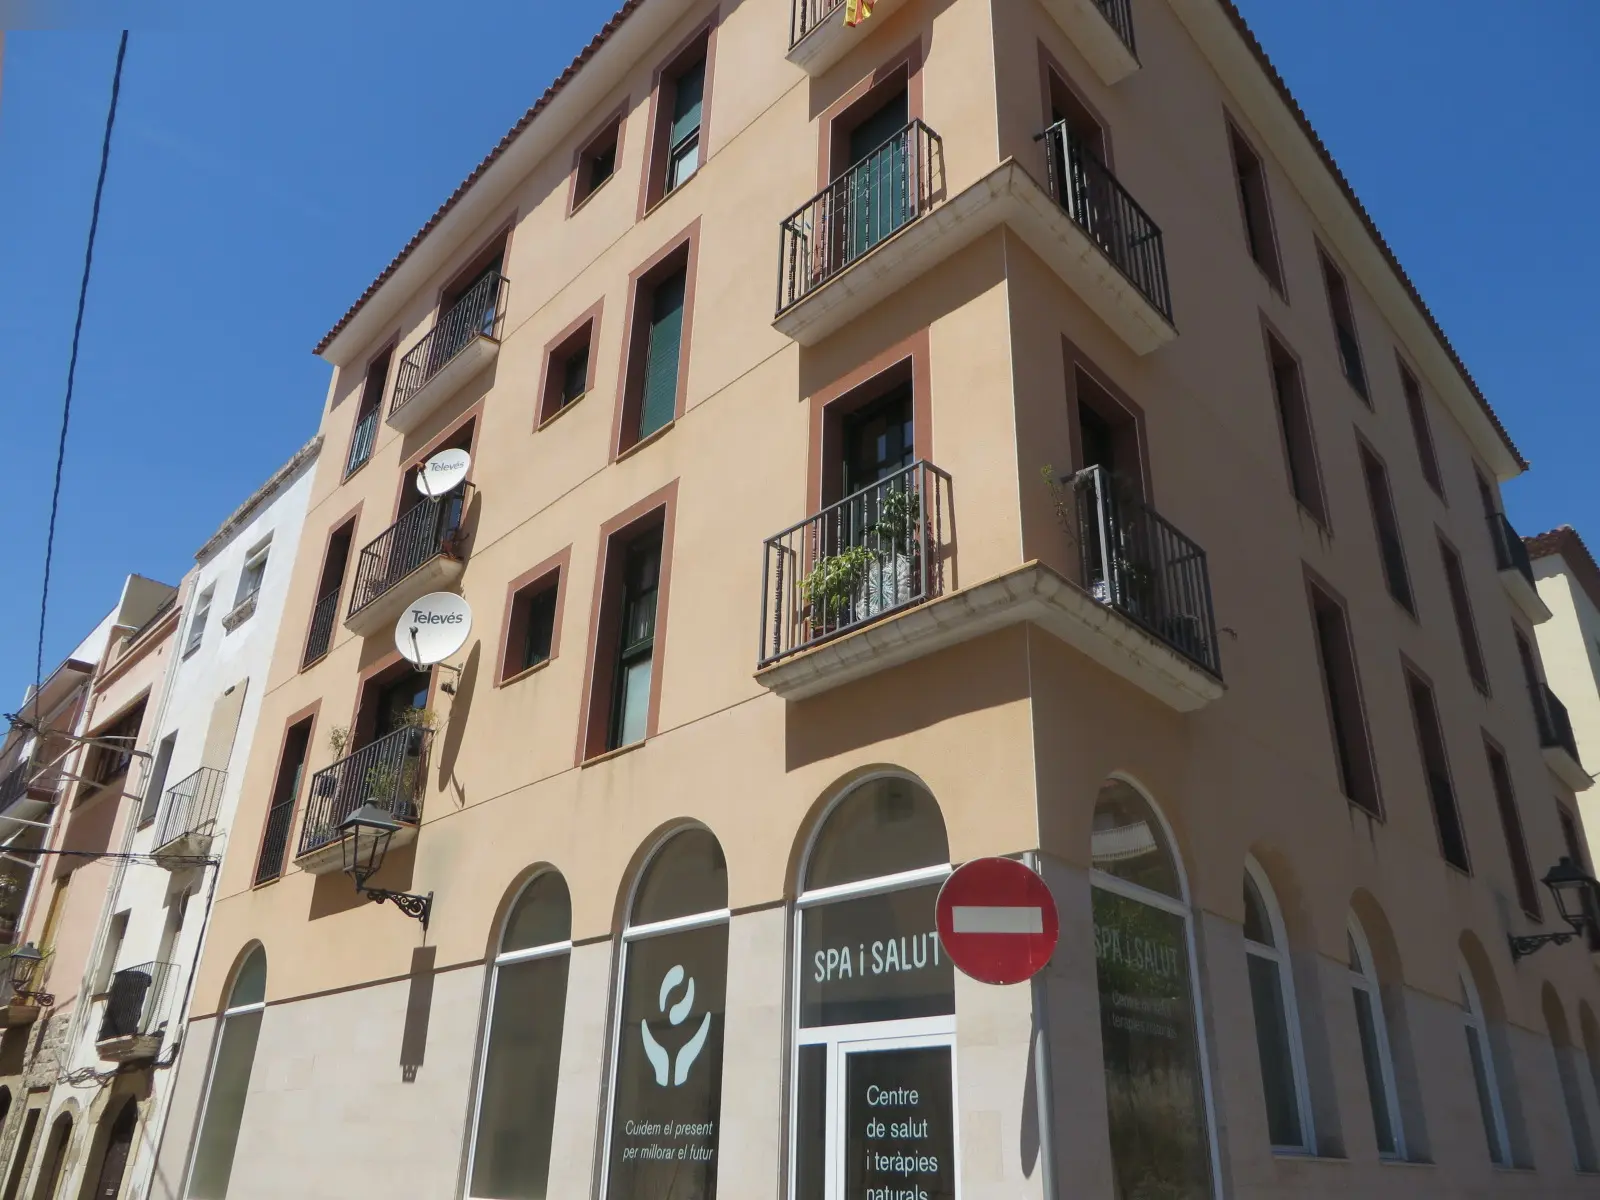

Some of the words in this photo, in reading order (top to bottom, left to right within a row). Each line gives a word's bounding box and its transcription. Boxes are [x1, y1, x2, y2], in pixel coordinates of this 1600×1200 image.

[411, 609, 463, 625] Televés
[814, 946, 852, 982] SPA
[859, 943, 864, 976] i
[872, 931, 939, 974] SALUT
[1134, 937, 1178, 978] SALUT
[866, 1084, 919, 1106] Centre
[625, 1119, 661, 1136] Cuidem
[663, 1119, 674, 1135] el
[674, 1120, 713, 1140] present
[866, 1116, 886, 1138] de
[890, 1116, 928, 1138] salut
[622, 1147, 639, 1163] per
[640, 1143, 675, 1160] millorar
[677, 1143, 688, 1160] el
[689, 1143, 714, 1161] futur
[866, 1149, 870, 1171] i
[874, 1149, 938, 1178] teràpies
[866, 1184, 928, 1200] naturals
